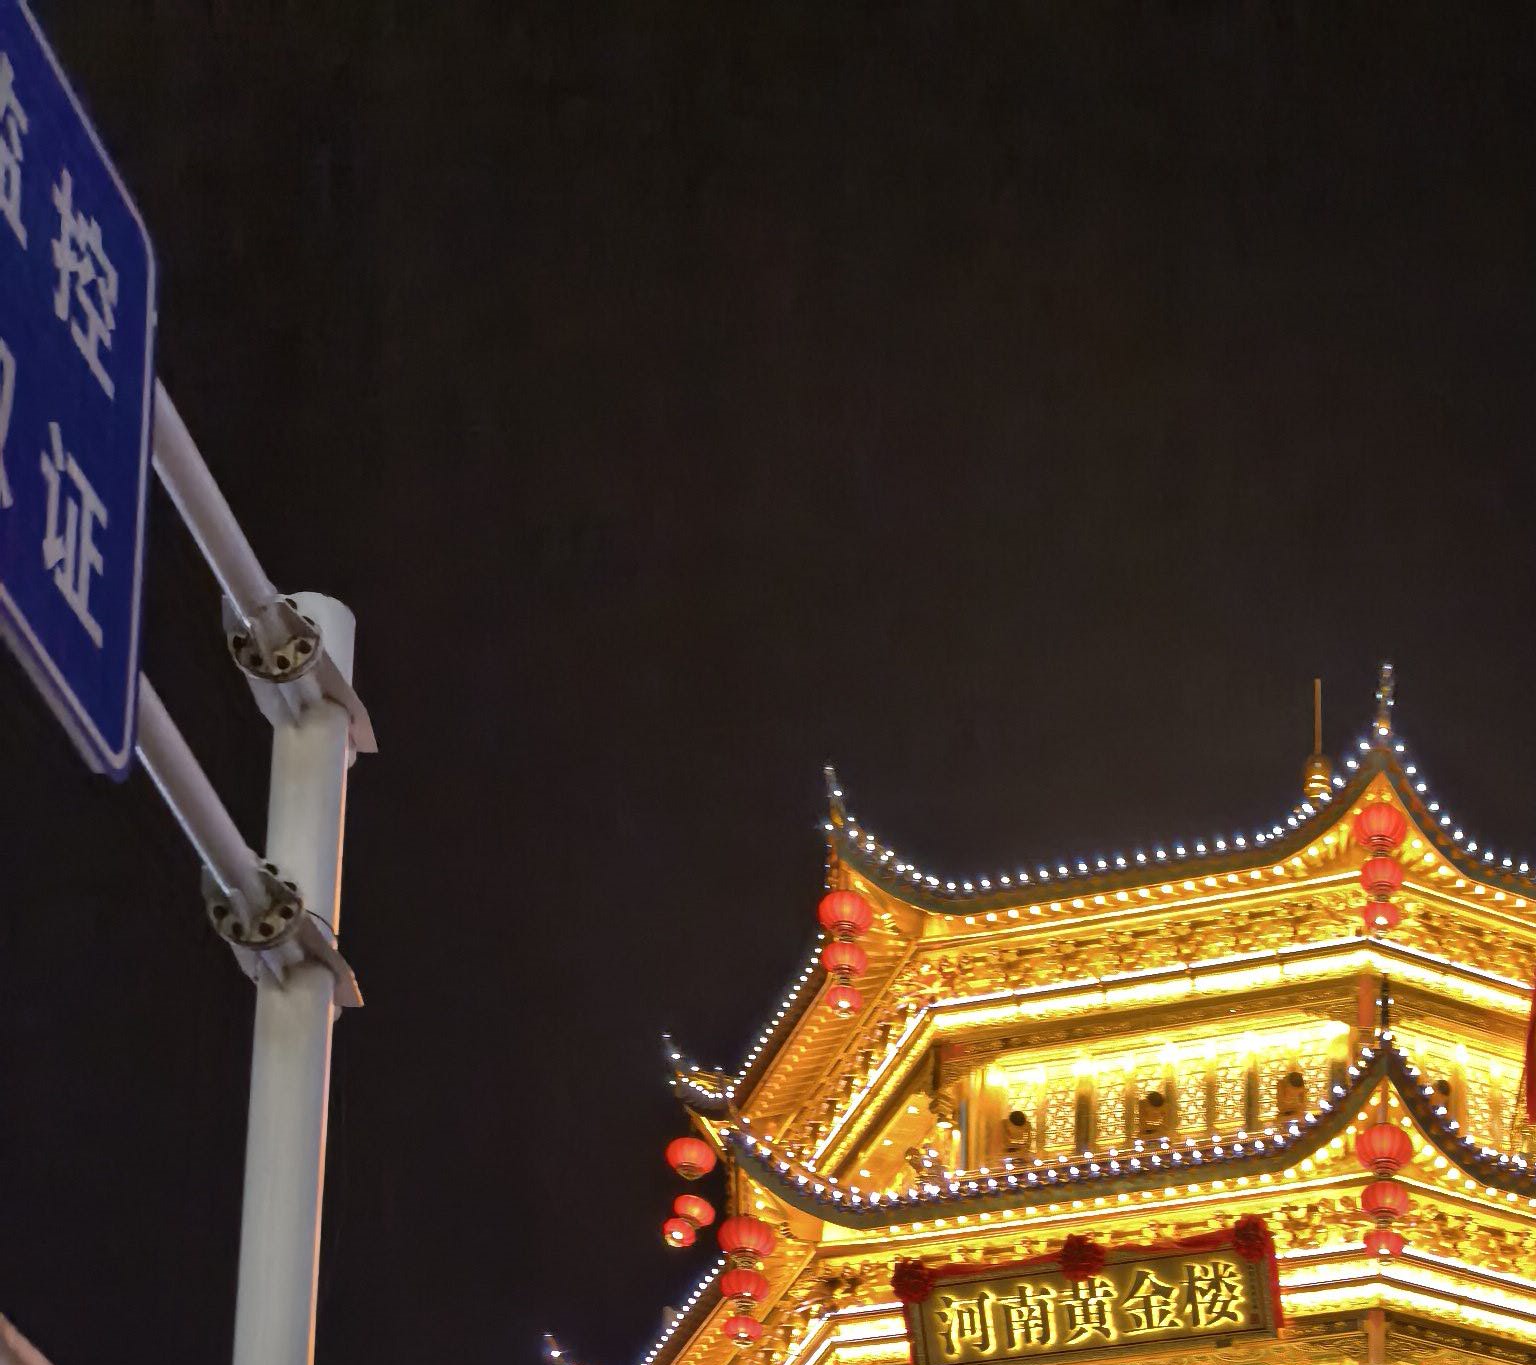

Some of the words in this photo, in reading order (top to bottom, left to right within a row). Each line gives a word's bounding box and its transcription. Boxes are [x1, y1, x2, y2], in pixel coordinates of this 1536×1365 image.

[0, 335, 108, 650] 证
[935, 1260, 1246, 1358] 河南黄金楼
